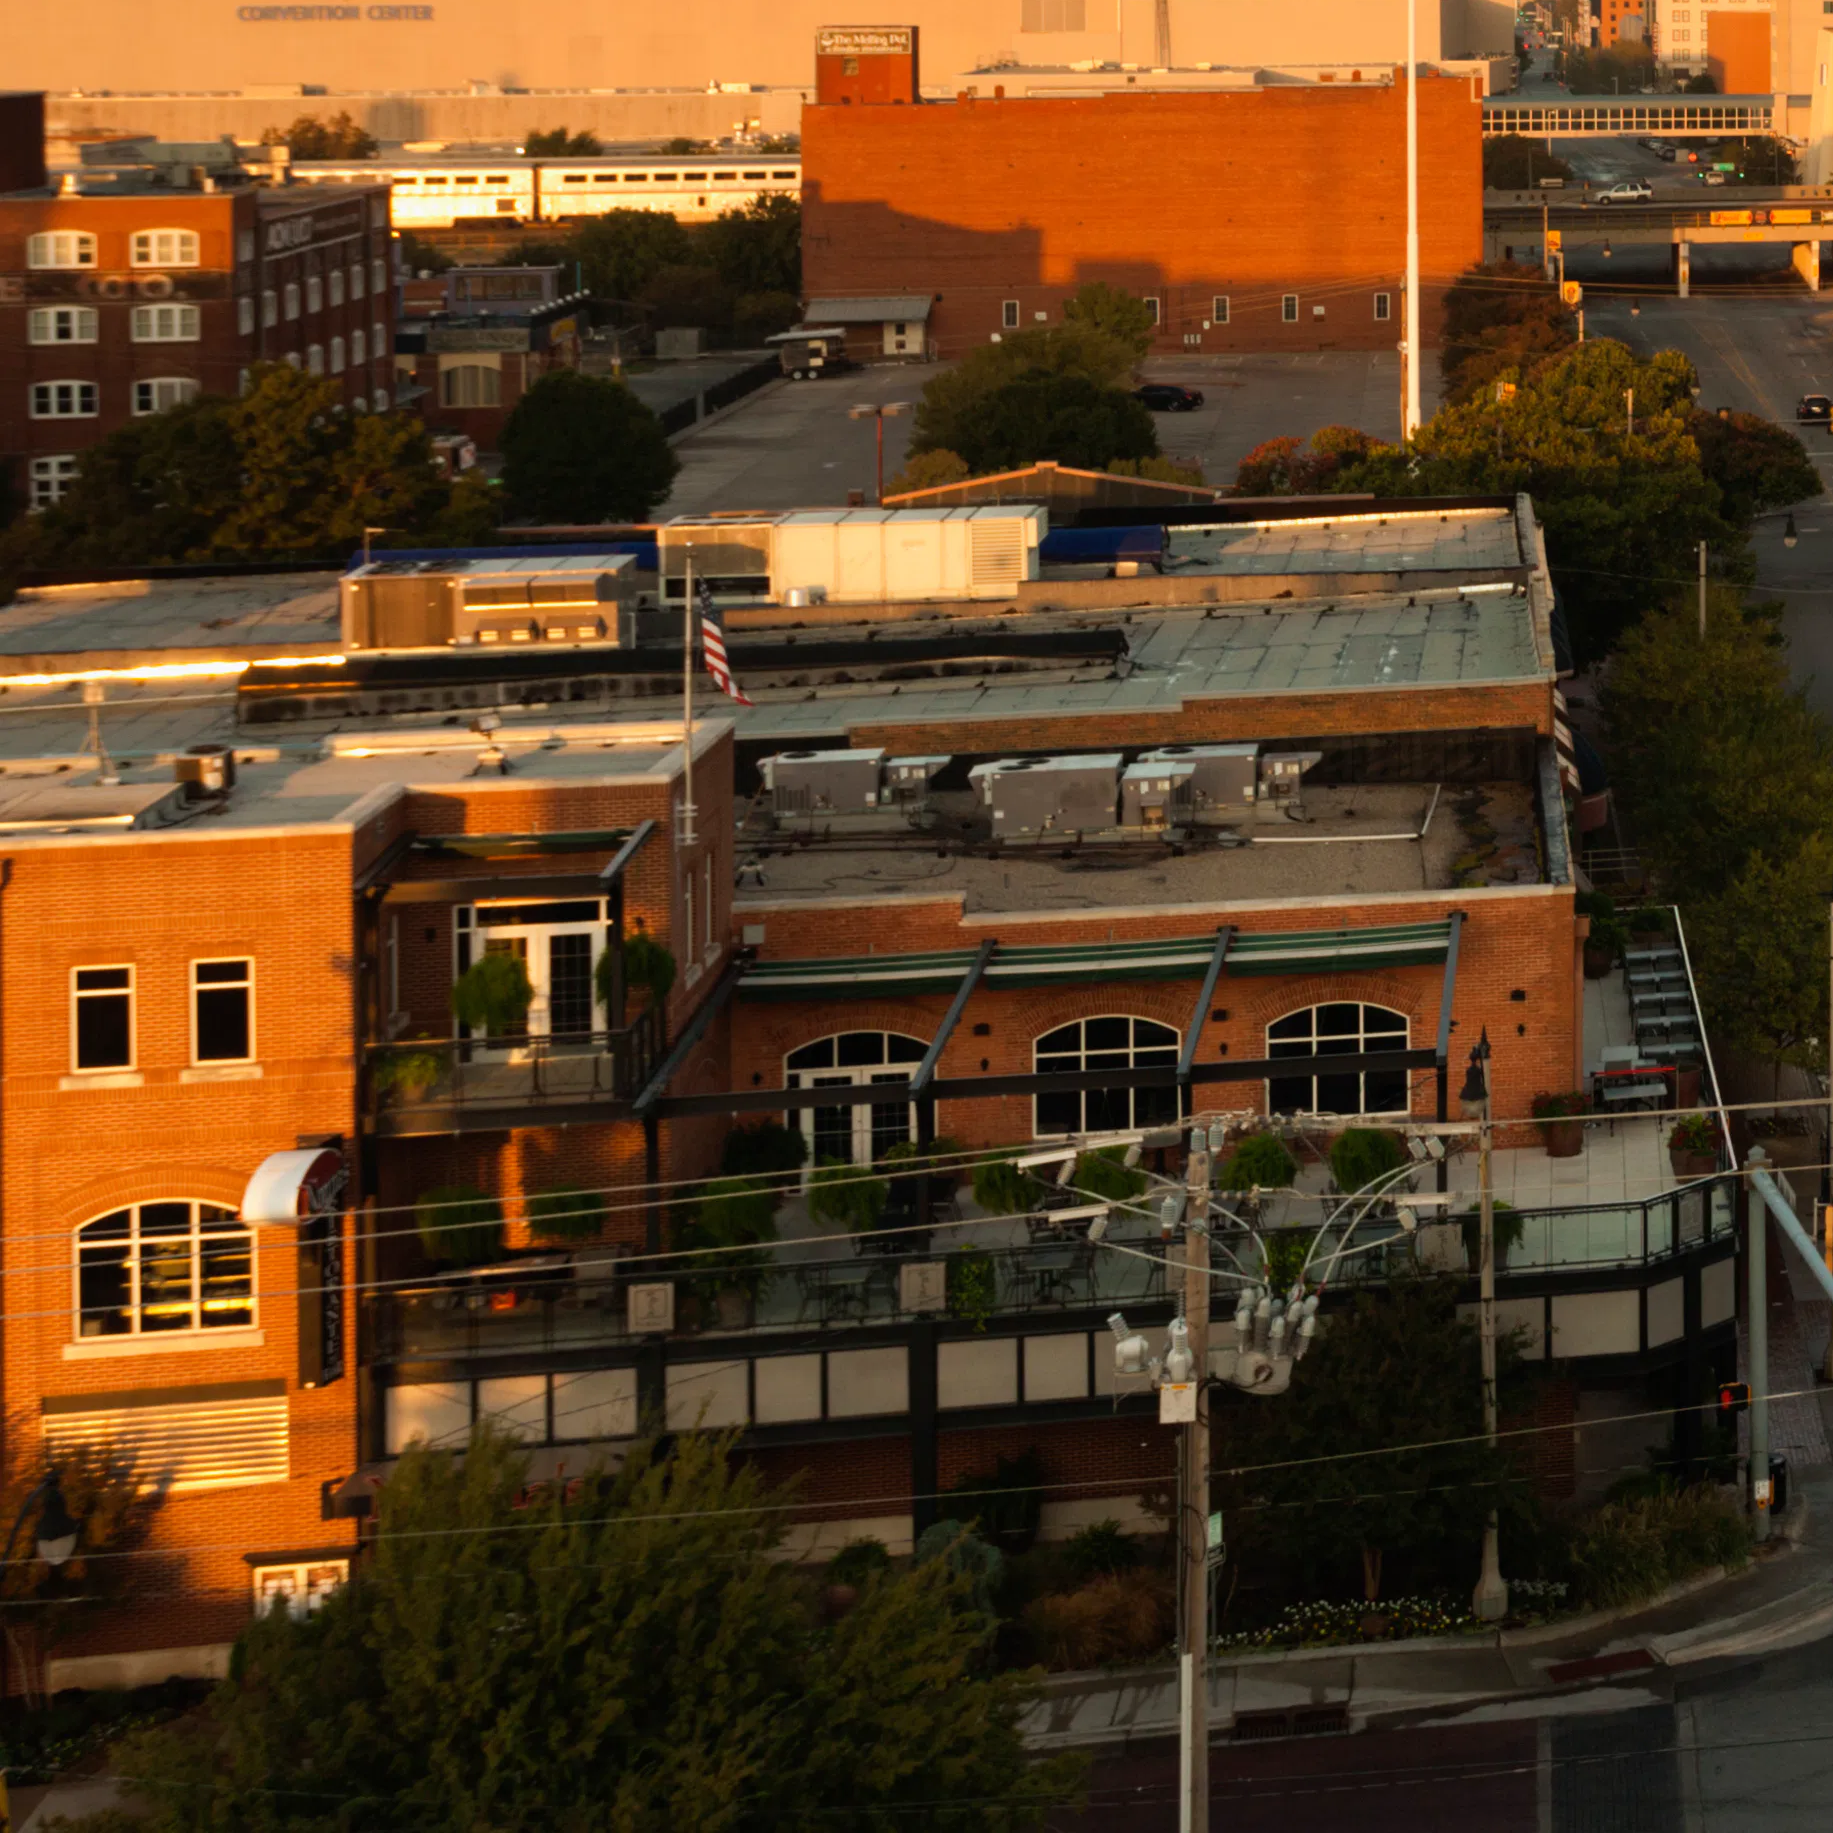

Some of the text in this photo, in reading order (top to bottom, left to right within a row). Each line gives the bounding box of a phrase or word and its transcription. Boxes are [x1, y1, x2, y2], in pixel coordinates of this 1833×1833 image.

[236, 5, 433, 21] CONVENTION CENTER
[833, 33, 852, 44] The
[853, 33, 888, 46] Melting
